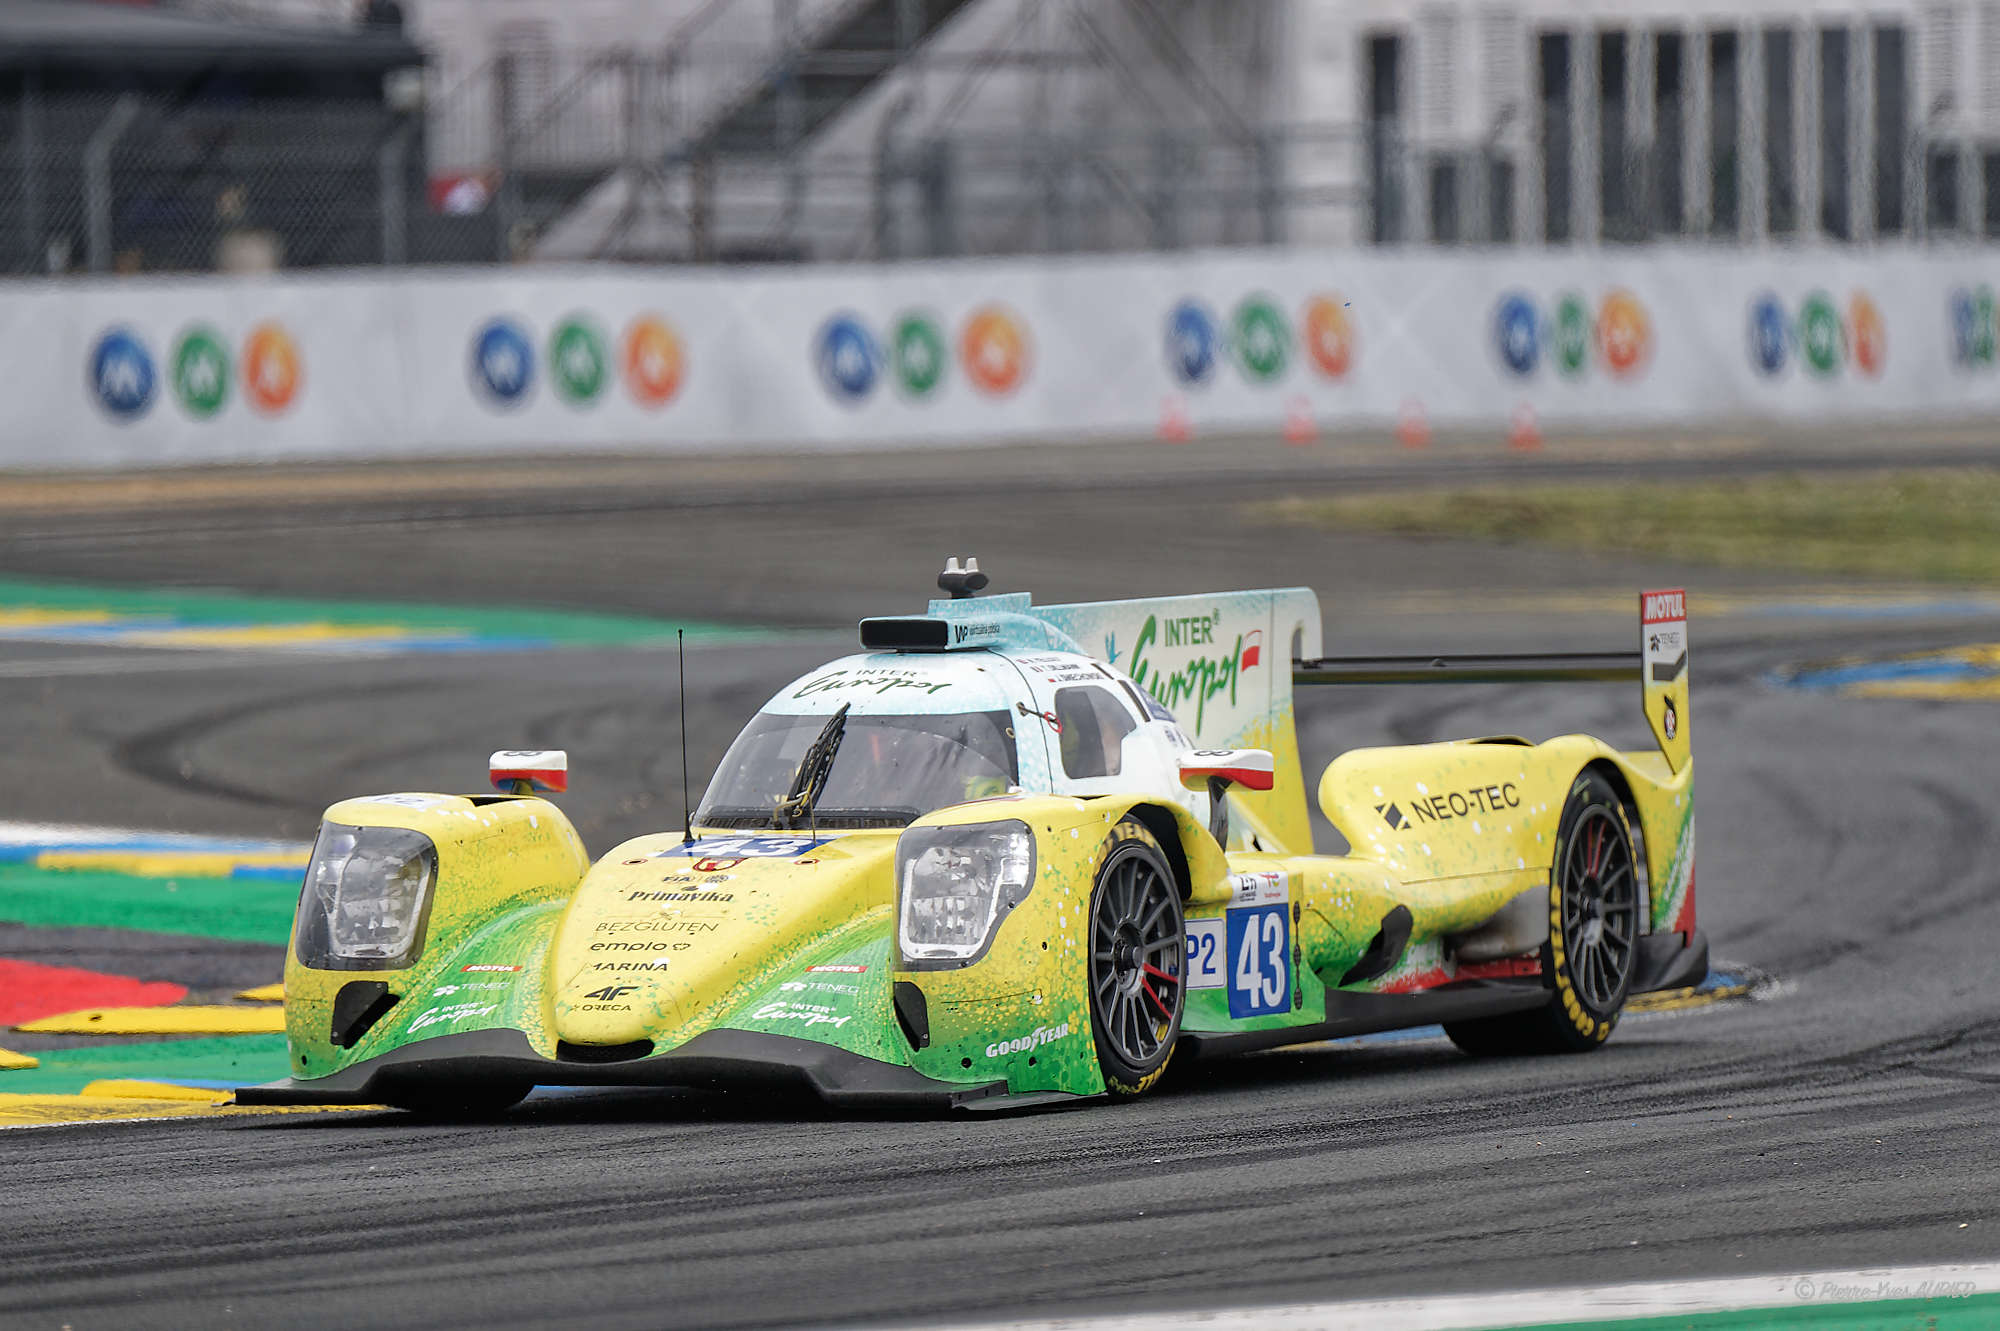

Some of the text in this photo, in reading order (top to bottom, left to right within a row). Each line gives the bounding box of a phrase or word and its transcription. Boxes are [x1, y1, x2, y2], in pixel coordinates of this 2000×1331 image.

[1645, 594, 1685, 619] MOTUL
[1411, 782, 1520, 823] NEO-TEC
[680, 839, 813, 856] 43
[595, 922, 719, 932] BEZGLUTEN
[590, 941, 667, 952] emplo
[1236, 912, 1286, 1009] 43
[985, 1022, 1069, 1058] GOODYEAR
